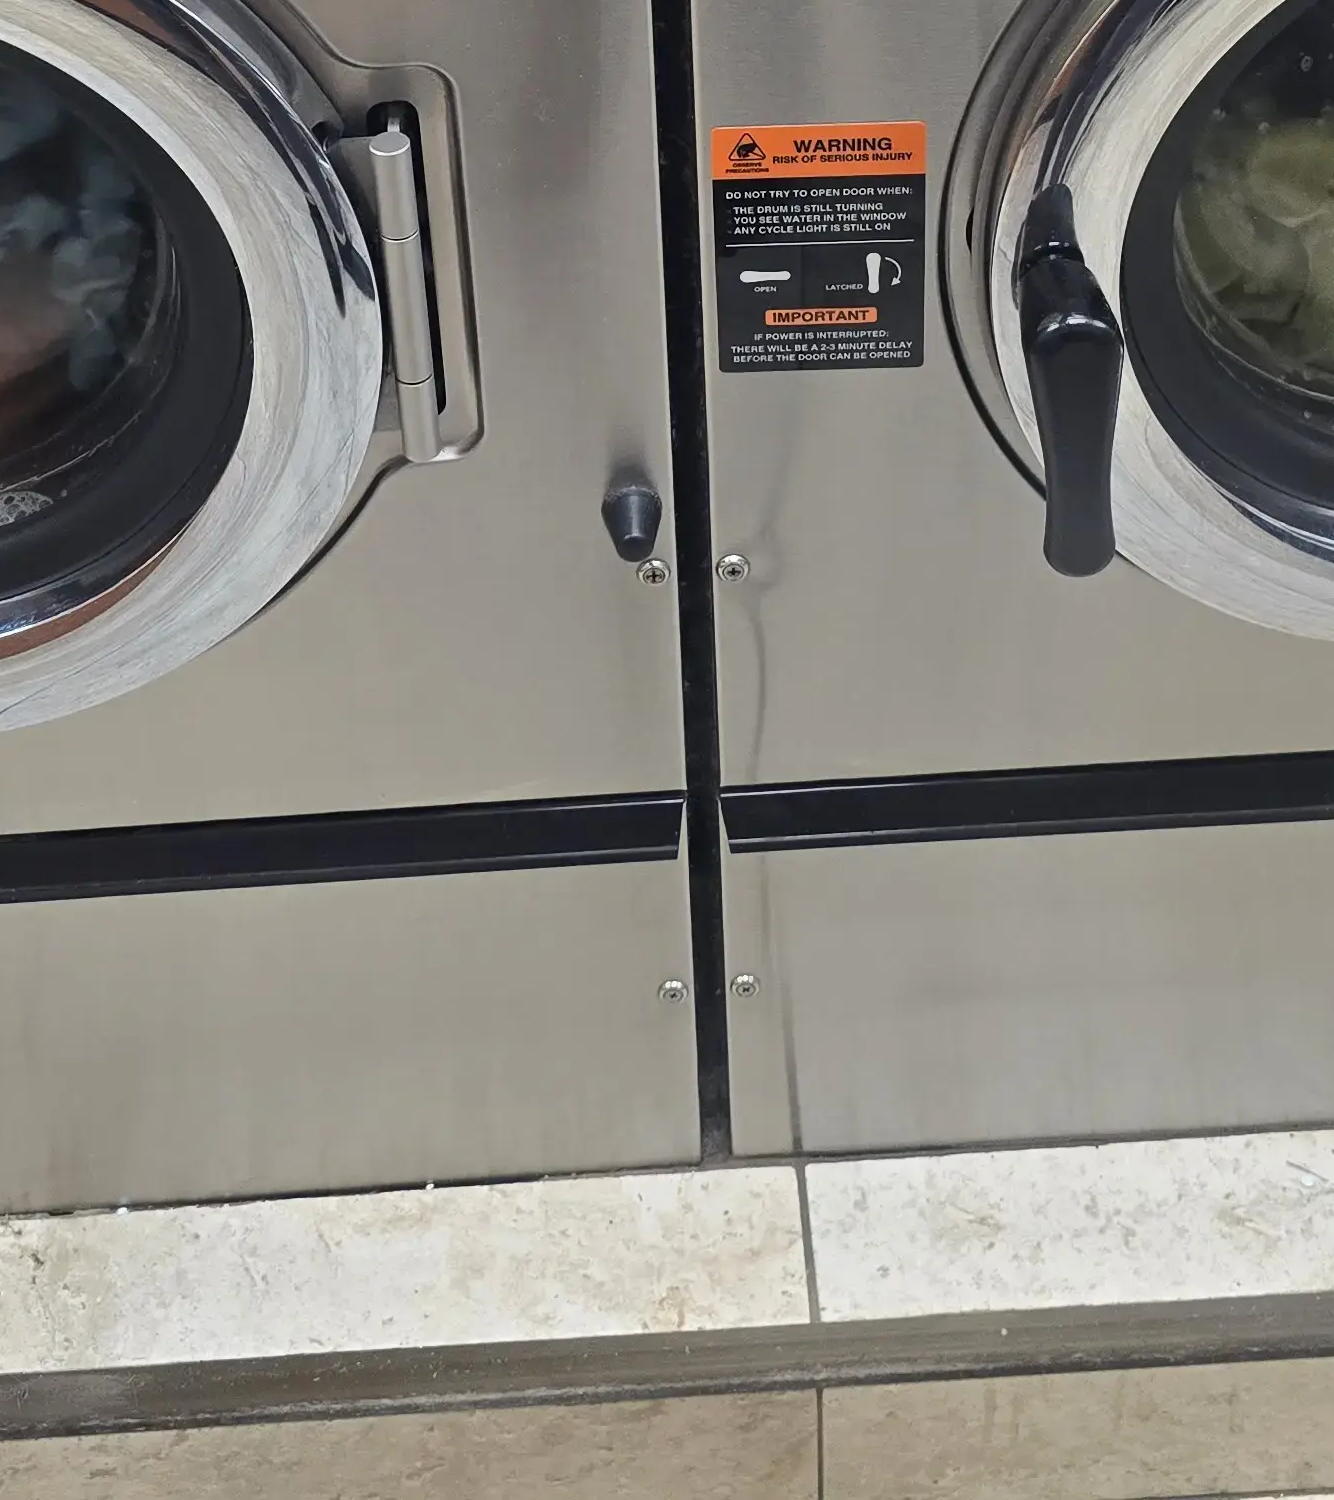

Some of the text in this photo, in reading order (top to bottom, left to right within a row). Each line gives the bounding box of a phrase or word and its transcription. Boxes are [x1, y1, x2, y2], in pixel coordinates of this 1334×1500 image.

[793, 137, 893, 153] WARNING
[772, 152, 913, 165] RISK OF SERIOUS INJURY
[725, 186, 913, 200] DO NOT TRY TO OPEN DOOR WHEN:
[754, 285, 777, 293] OPEN
[825, 283, 864, 291] LATCHED
[772, 310, 870, 323] IMPORTANT
